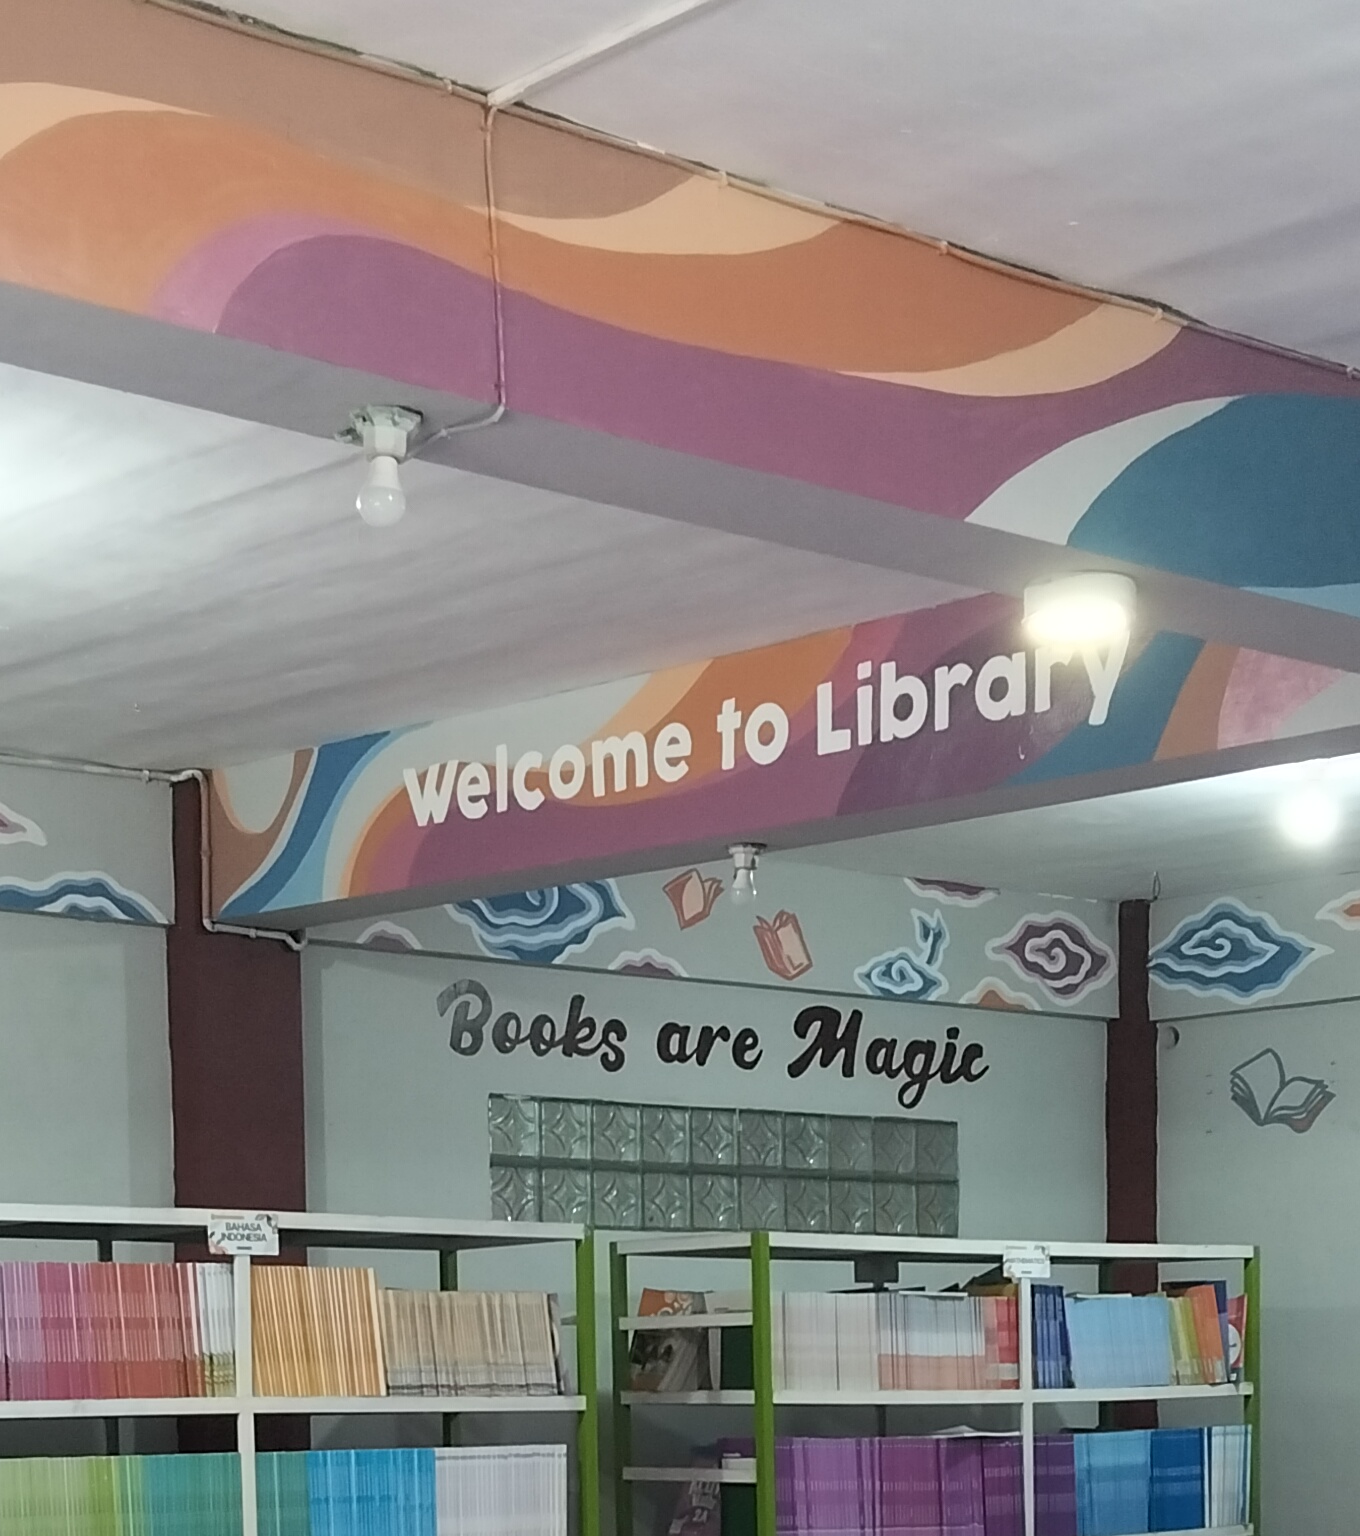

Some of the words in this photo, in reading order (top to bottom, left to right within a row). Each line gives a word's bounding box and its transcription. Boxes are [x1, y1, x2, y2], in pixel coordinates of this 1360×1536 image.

[402, 720, 693, 827] Welcome
[716, 696, 790, 770] to
[816, 630, 1130, 757] Library
[436, 978, 628, 1073] Books
[656, 1020, 764, 1071] are
[787, 1004, 990, 1109] Magic
[220, 1232, 268, 1242] INDONESIA
[225, 1222, 262, 1232] BAHASA
